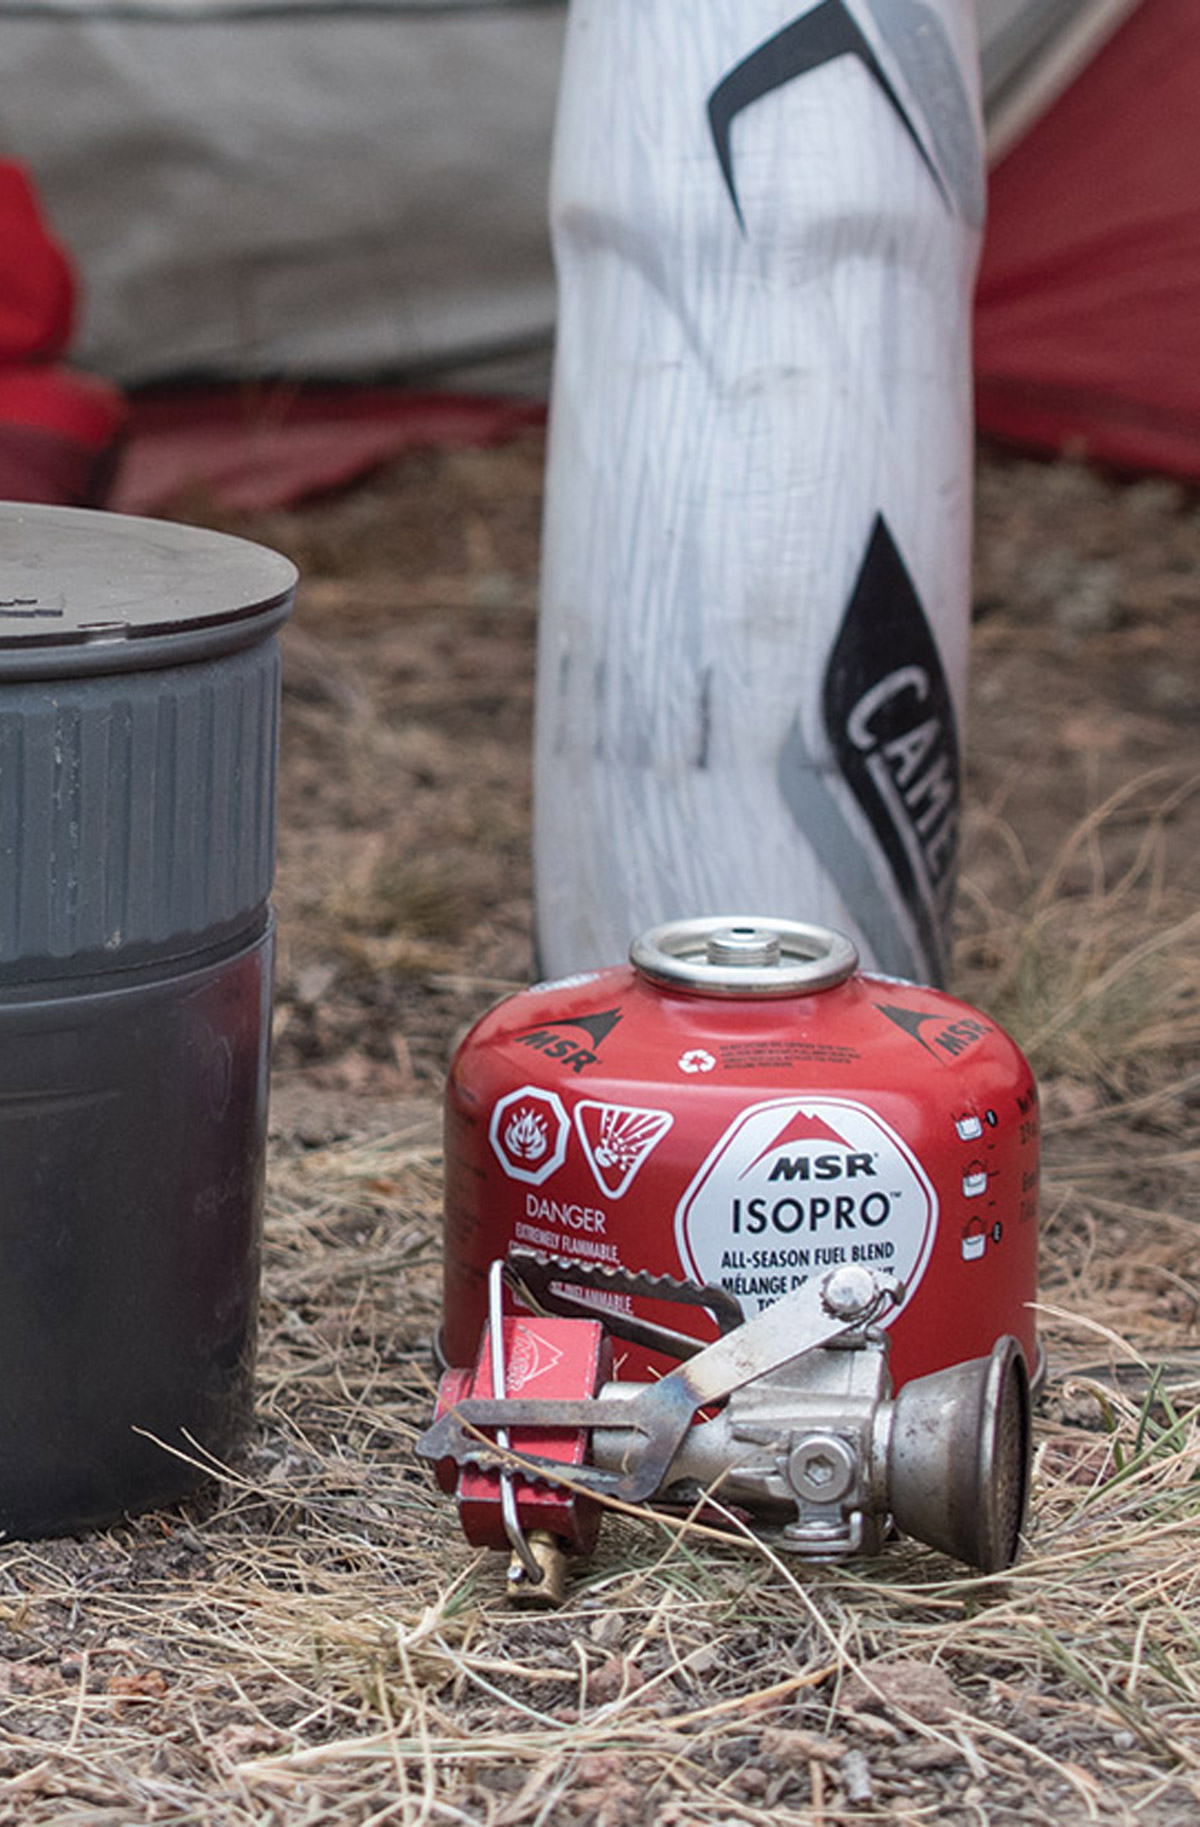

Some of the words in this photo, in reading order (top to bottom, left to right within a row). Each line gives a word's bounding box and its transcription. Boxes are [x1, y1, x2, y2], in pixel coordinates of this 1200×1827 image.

[513, 1029, 598, 1075] MSR
[934, 1018, 988, 1057] MSR
[767, 1152, 878, 1182] MSR
[526, 1193, 607, 1235] DANGER
[721, 1250, 810, 1270] ALL-SEASON
[814, 1246, 847, 1266] FUEL
[851, 1241, 896, 1263] BLEND
